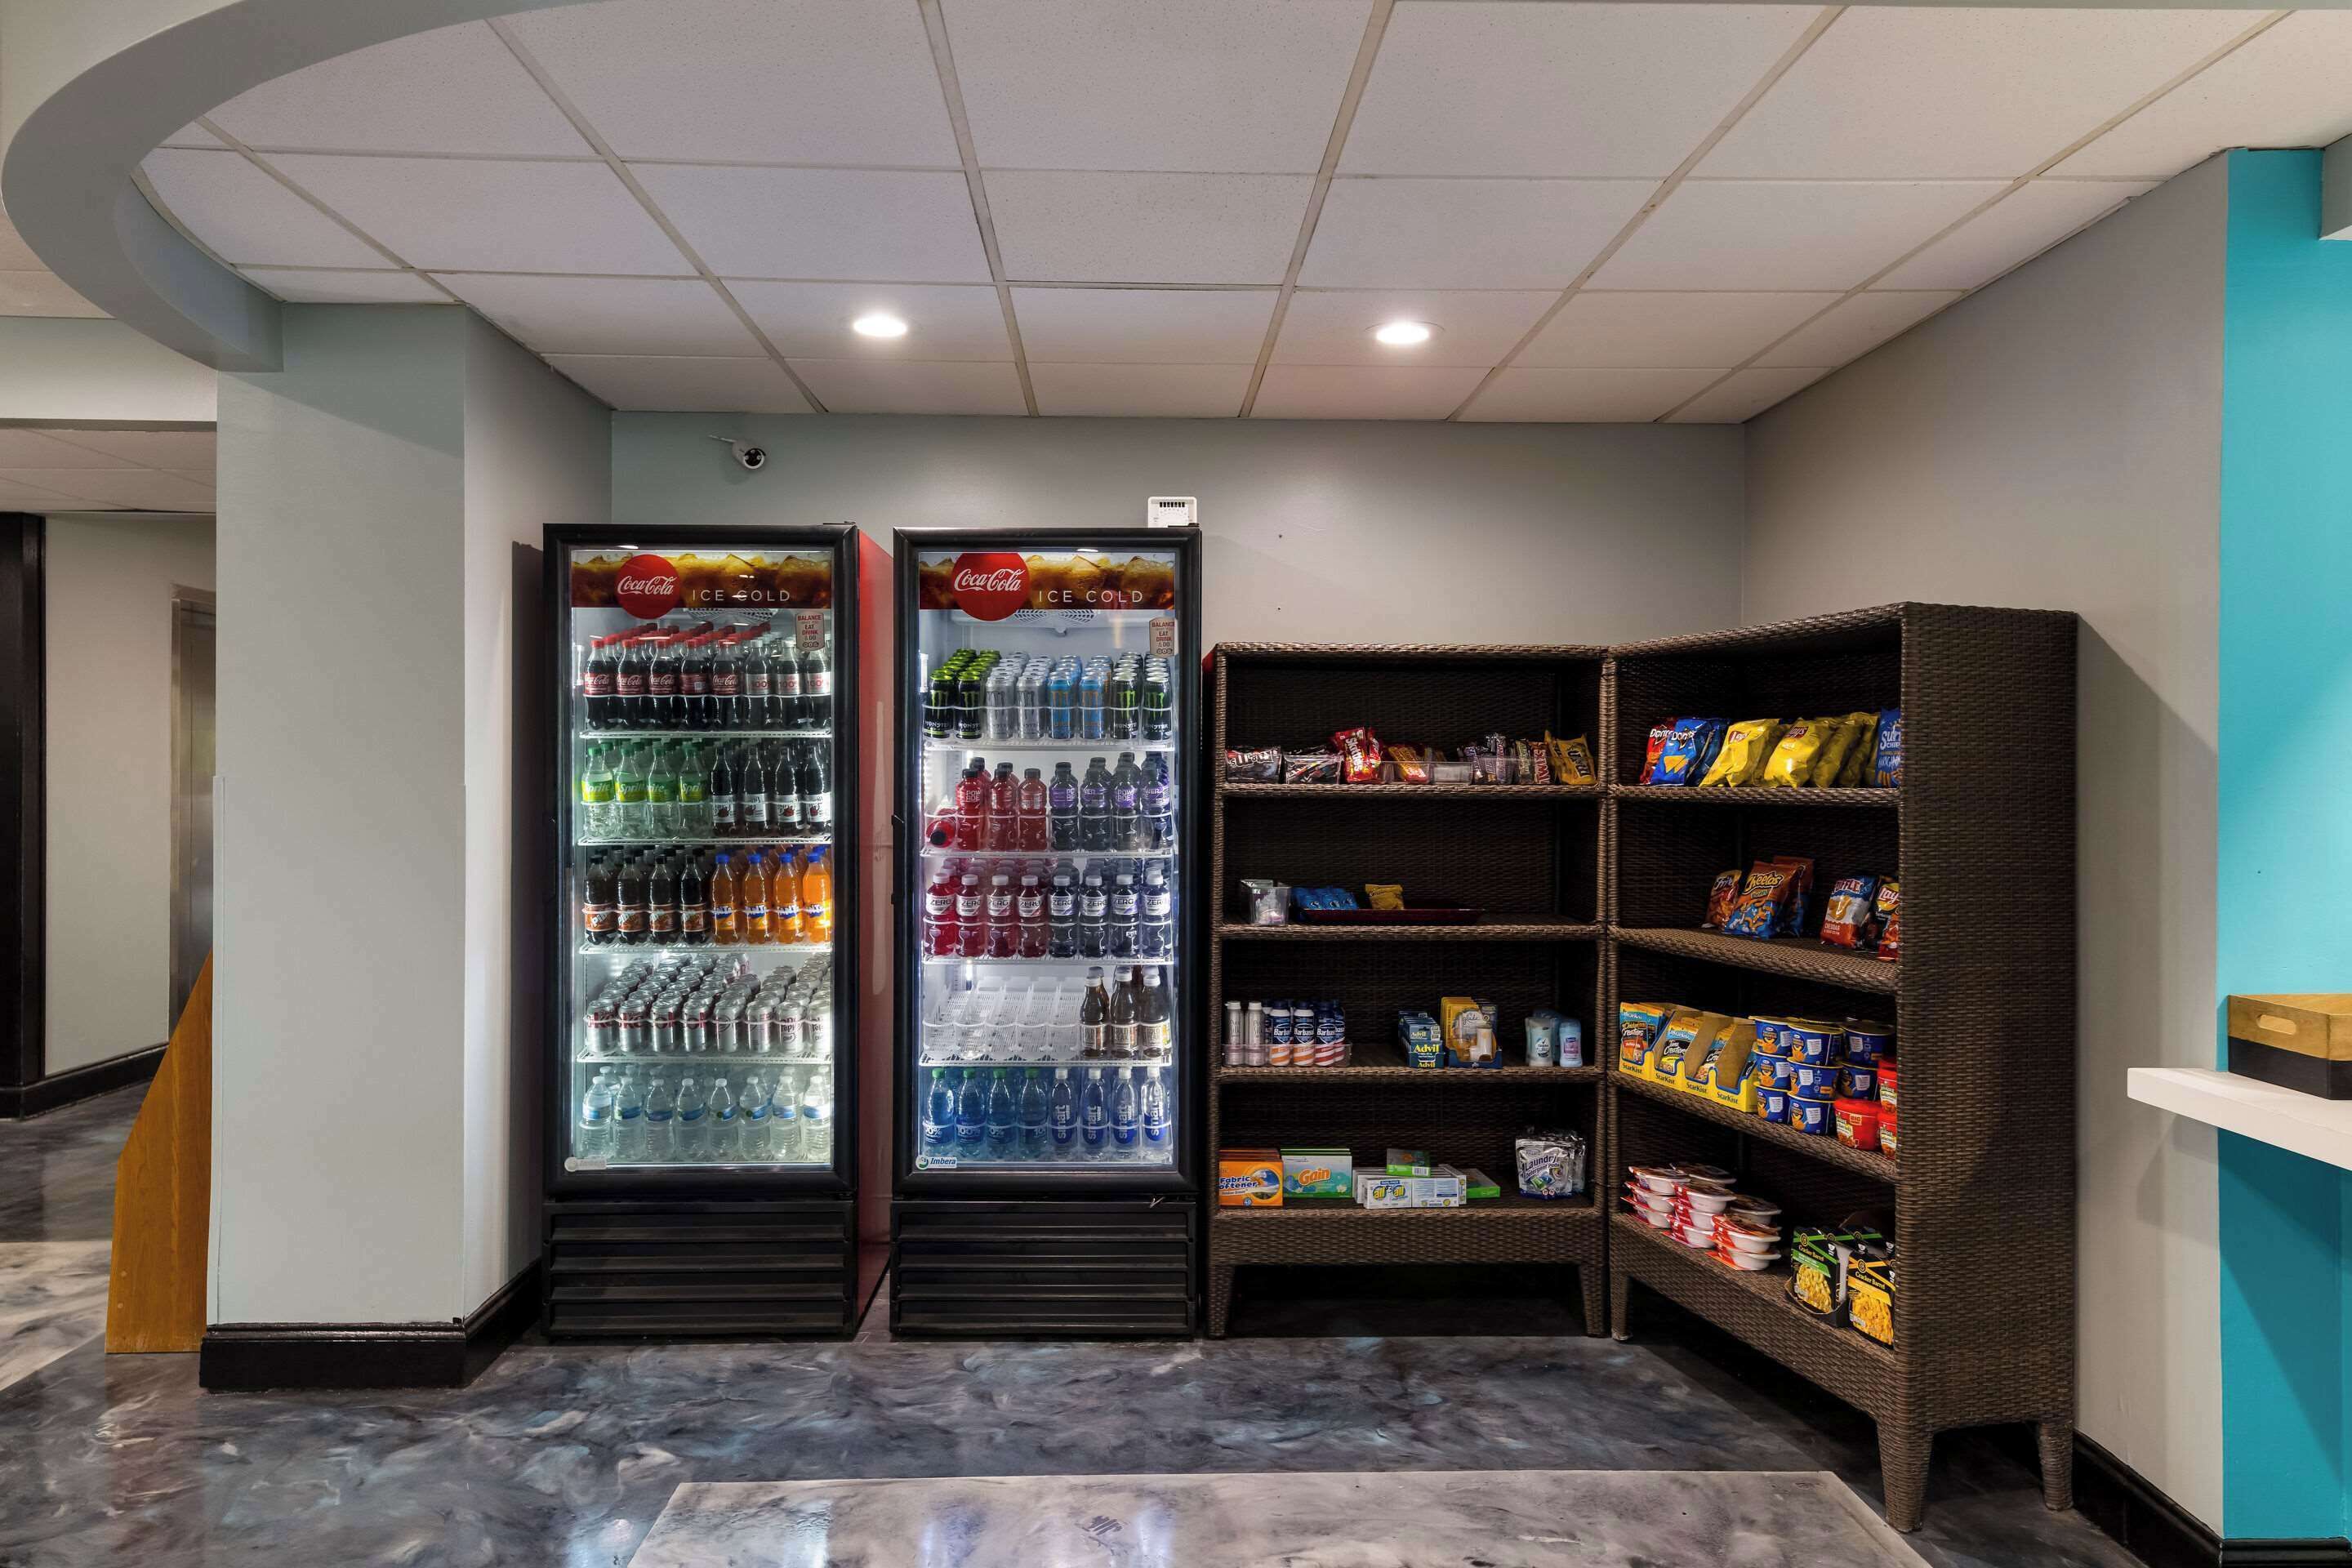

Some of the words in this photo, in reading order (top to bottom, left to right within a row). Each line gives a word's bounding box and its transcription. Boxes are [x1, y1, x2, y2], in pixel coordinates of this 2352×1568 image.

[617, 575, 677, 595] Coca-Cola
[954, 568, 1025, 592] Coca-Cola
[693, 590, 724, 602] ICE
[737, 590, 791, 602] COLD
[1039, 590, 1072, 602] ICE
[1086, 590, 1143, 602] COLD
[1878, 887, 1899, 904] Lay
[1414, 1044, 1440, 1053] Advil
[1655, 1072, 1675, 1085] StarKist
[1717, 1091, 1738, 1104] StarKist
[1526, 1154, 1557, 1170] Laundry
[1298, 1168, 1331, 1186] Gain
[1855, 1271, 1872, 1283] Cracker
[1872, 1279, 1885, 1290] Barrel
